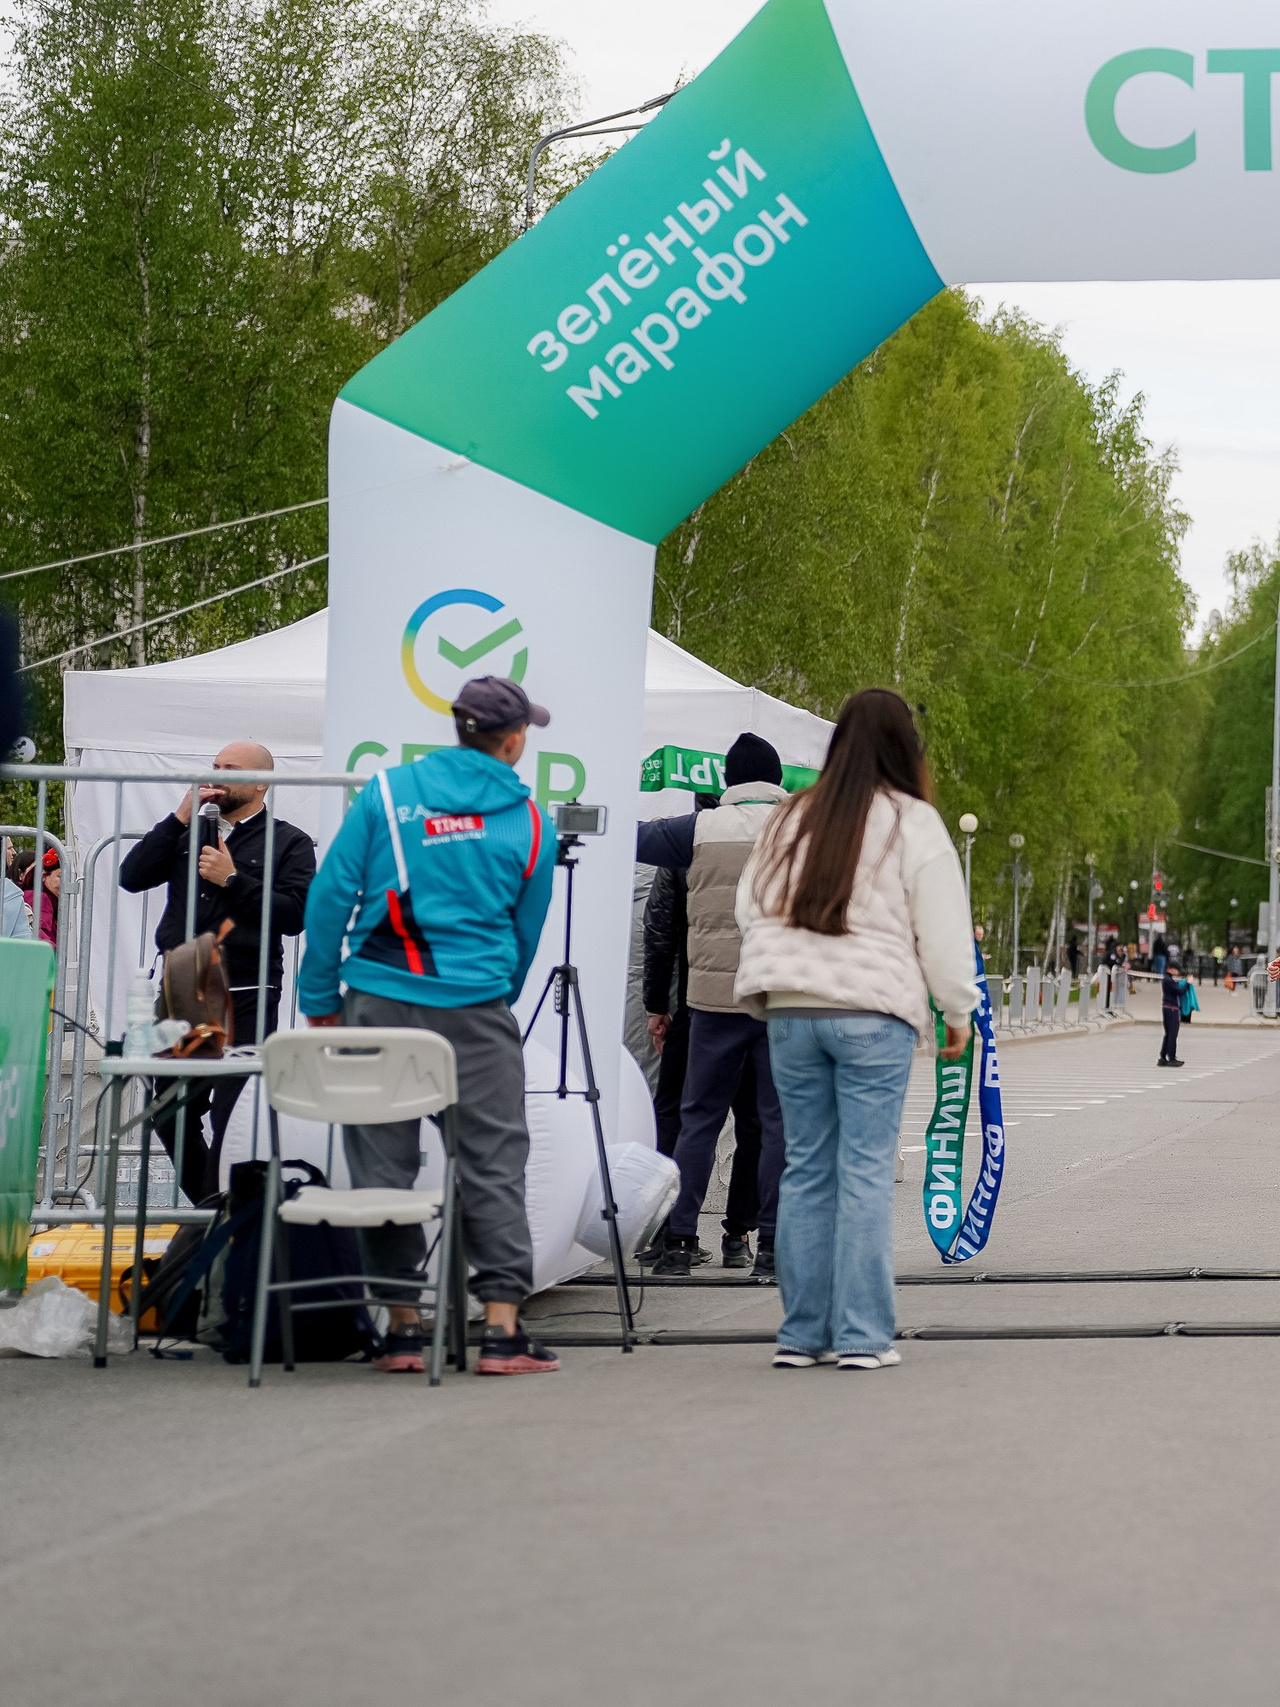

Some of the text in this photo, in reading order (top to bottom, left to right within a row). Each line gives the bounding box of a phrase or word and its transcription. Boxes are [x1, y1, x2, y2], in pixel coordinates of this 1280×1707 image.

[526, 138, 767, 372] зелёный
[565, 193, 809, 420] марафон
[928, 1066, 967, 1229] ФИНИШ
